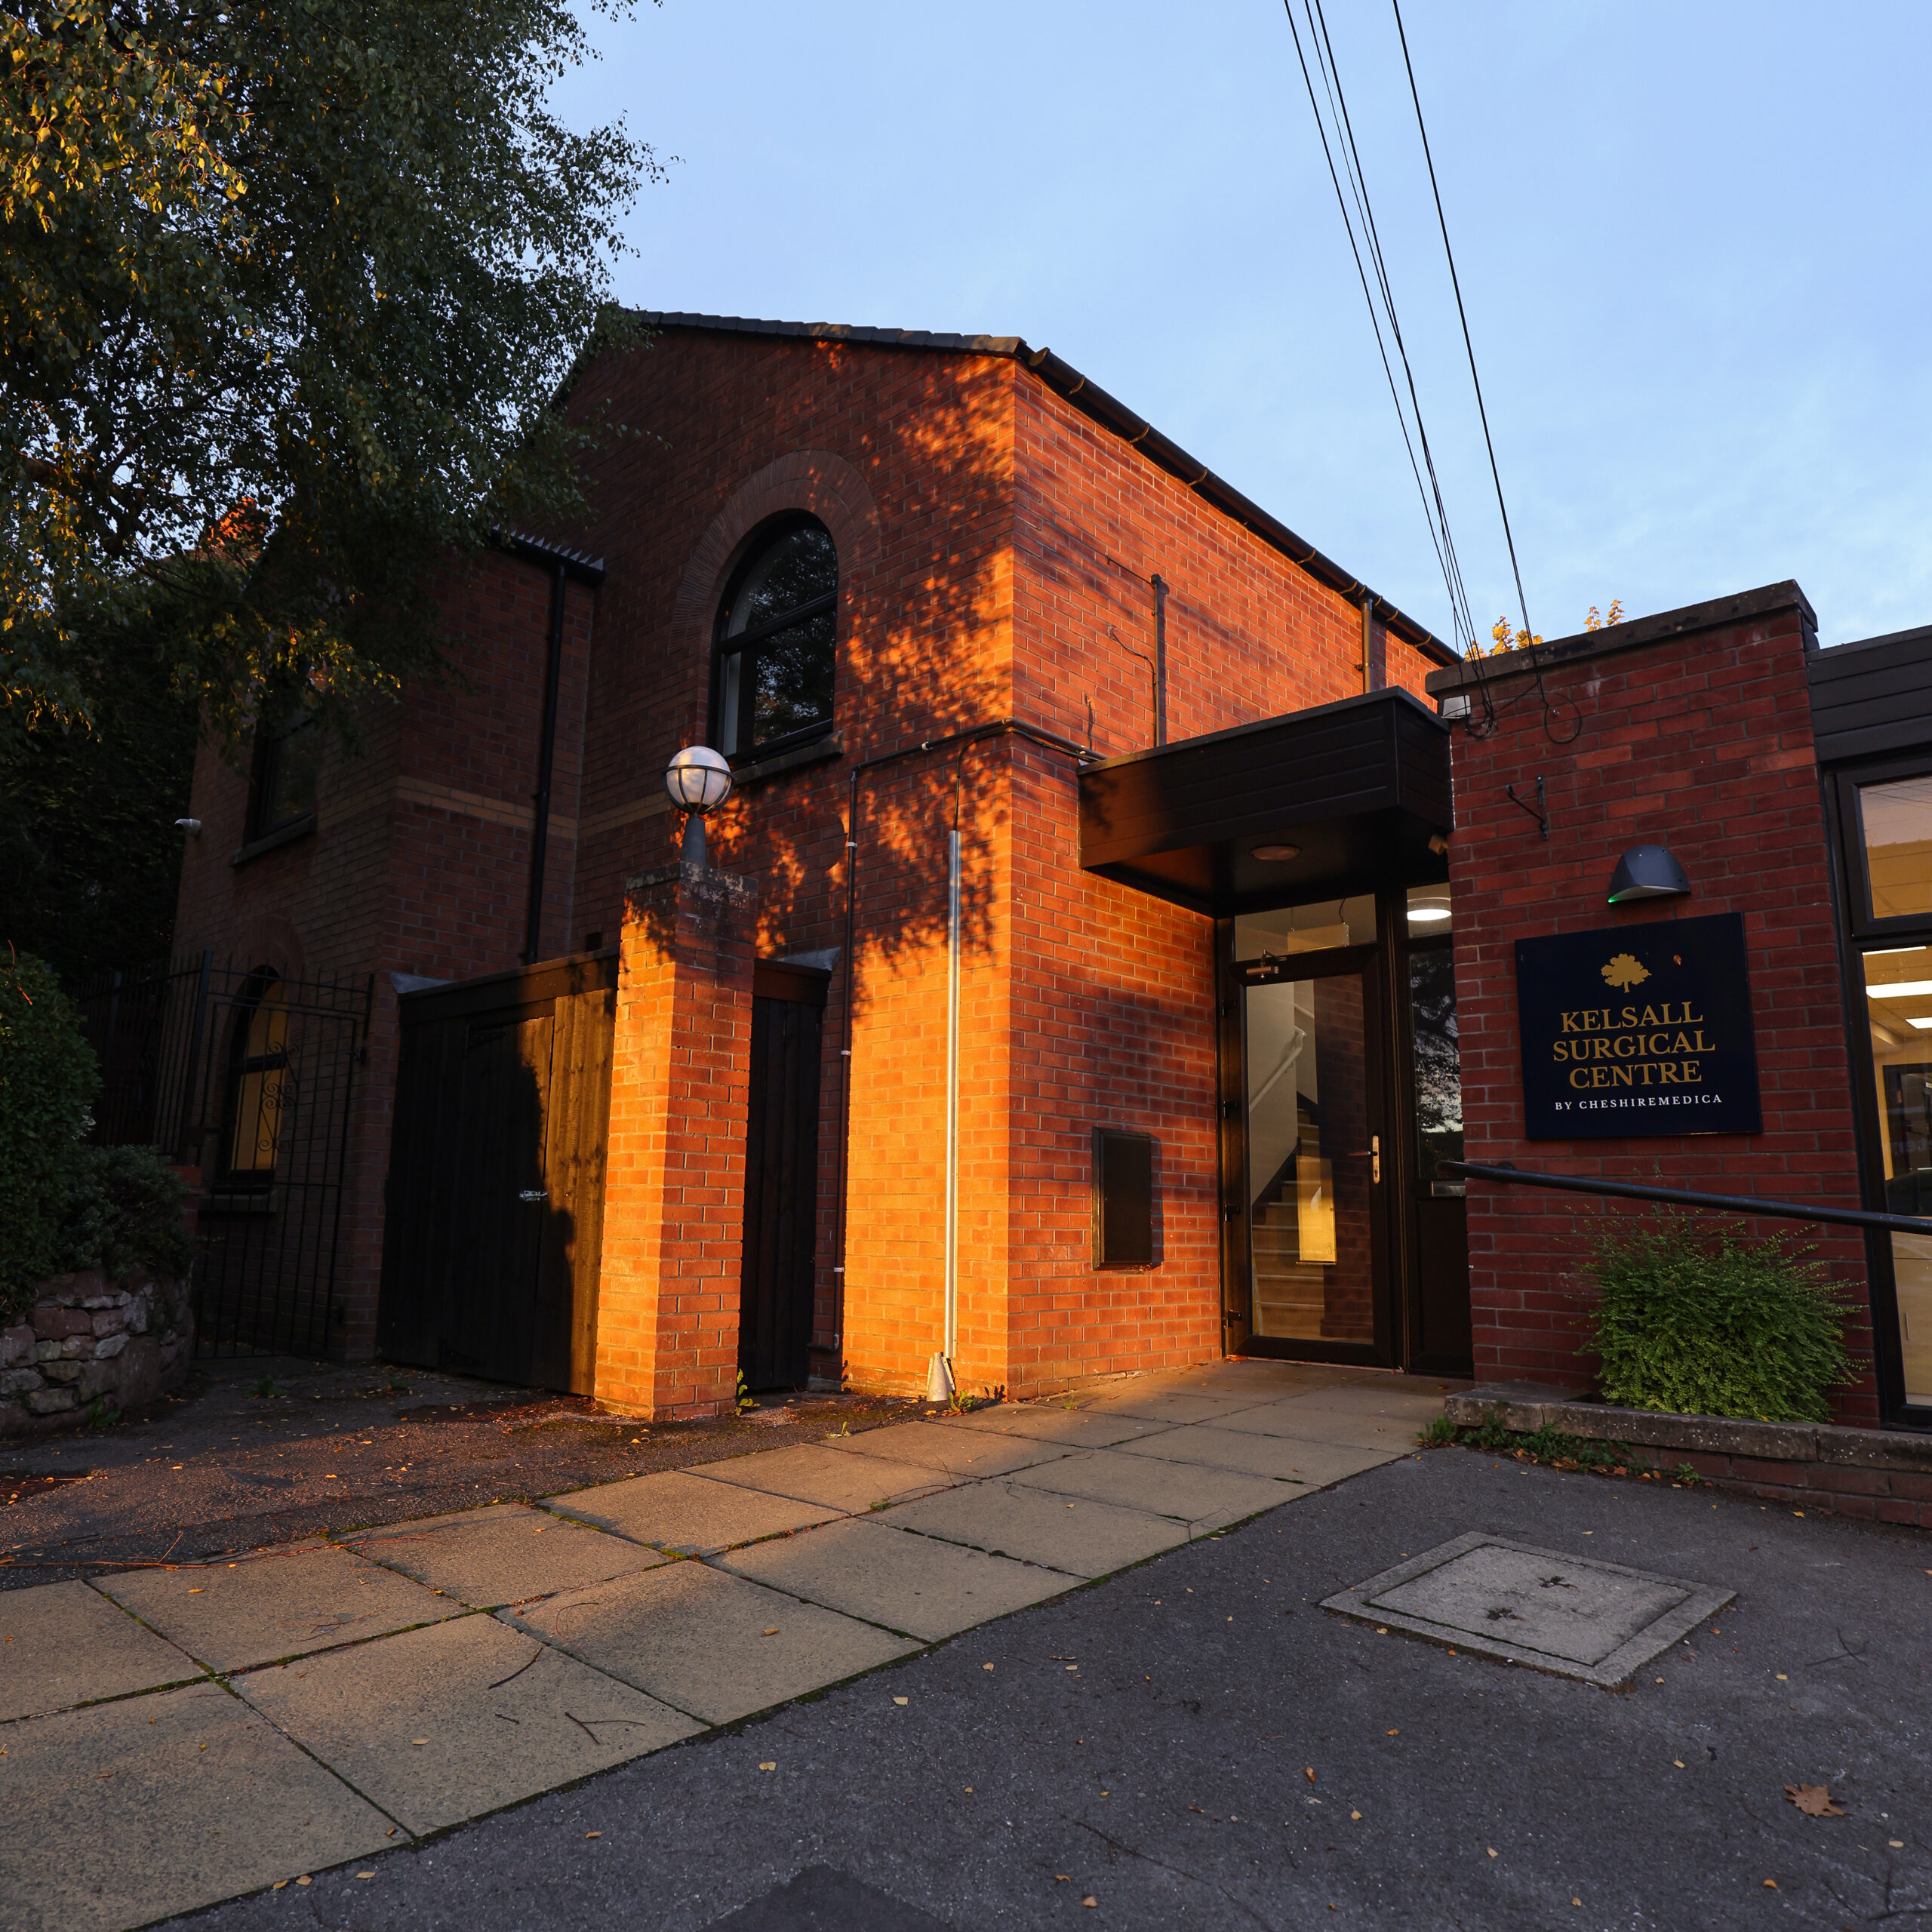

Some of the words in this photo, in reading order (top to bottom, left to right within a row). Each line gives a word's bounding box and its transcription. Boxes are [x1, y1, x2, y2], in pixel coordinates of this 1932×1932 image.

[1560, 1001, 1703, 1033] KELSALL
[1553, 1030, 1715, 1061] SURGICAL
[1569, 1060, 1702, 1089] CENTRE
[1555, 1101, 1572, 1110] BY
[1579, 1094, 1722, 1109] CHESHIREMEDICA
